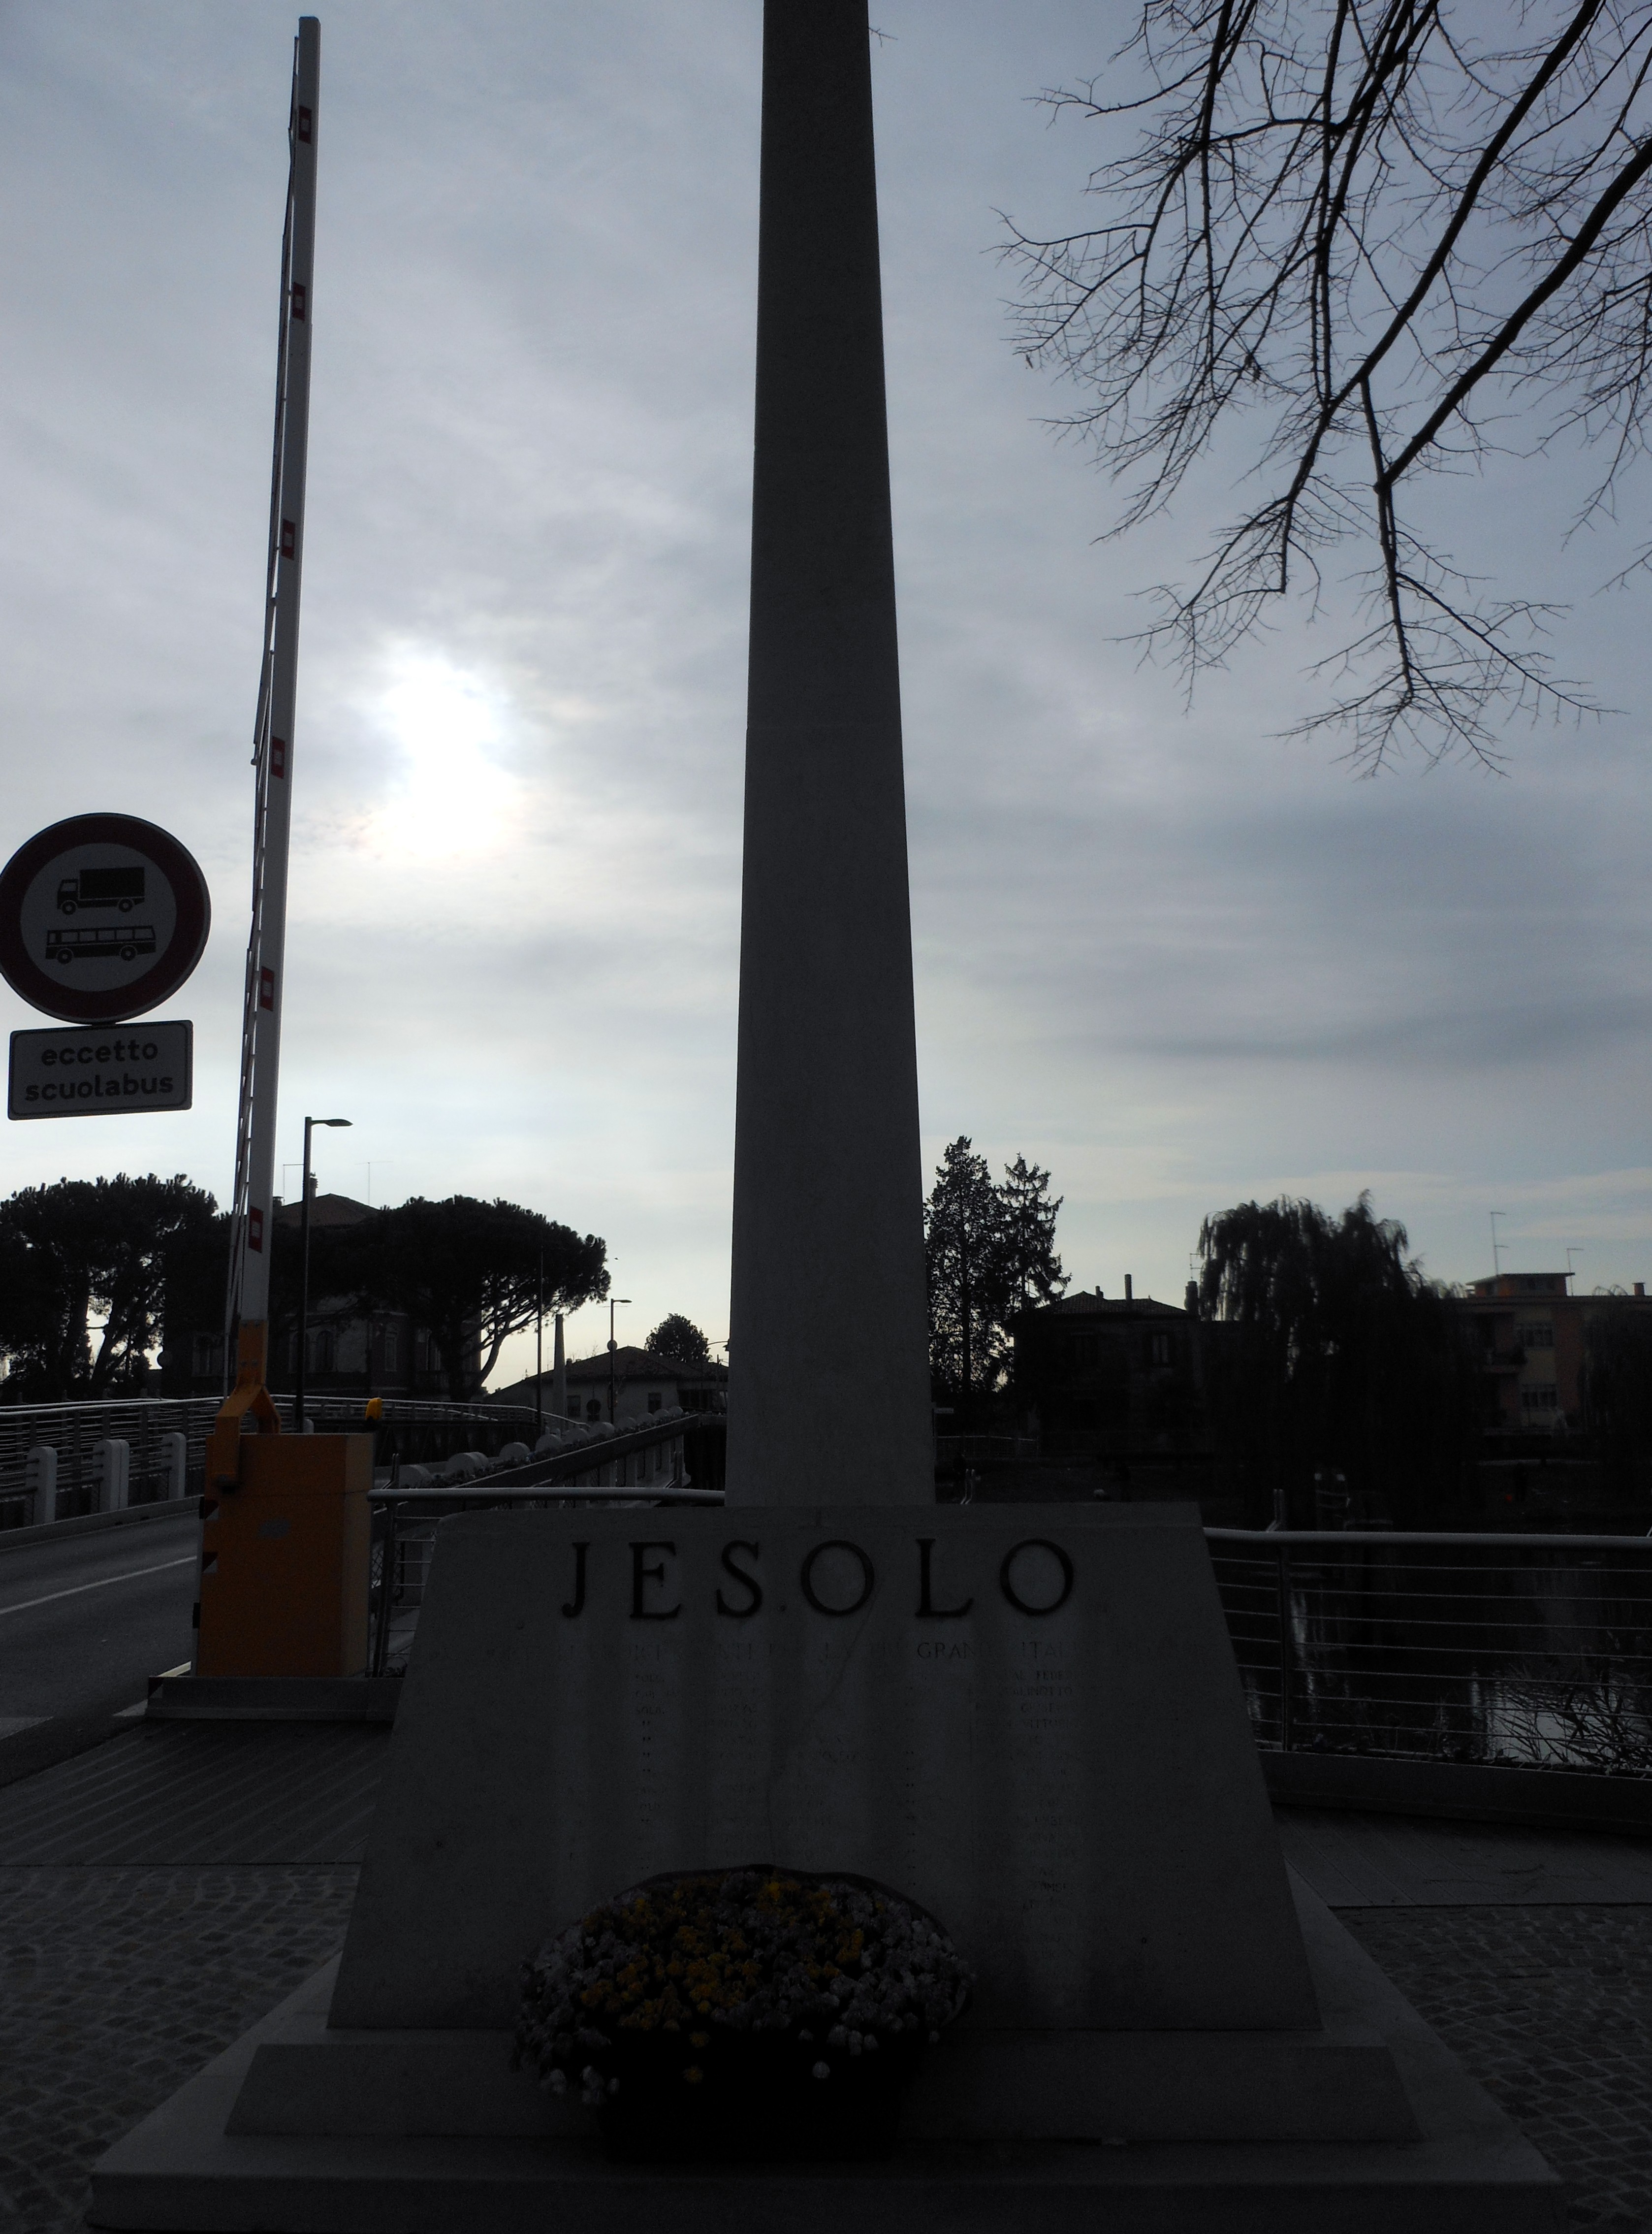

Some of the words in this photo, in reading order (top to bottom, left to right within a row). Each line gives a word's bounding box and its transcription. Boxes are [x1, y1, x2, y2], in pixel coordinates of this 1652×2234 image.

[41, 1040, 159, 1066] eccetto
[25, 1073, 174, 1101] scuolabus
[561, 1538, 1075, 1621] JESOLO
